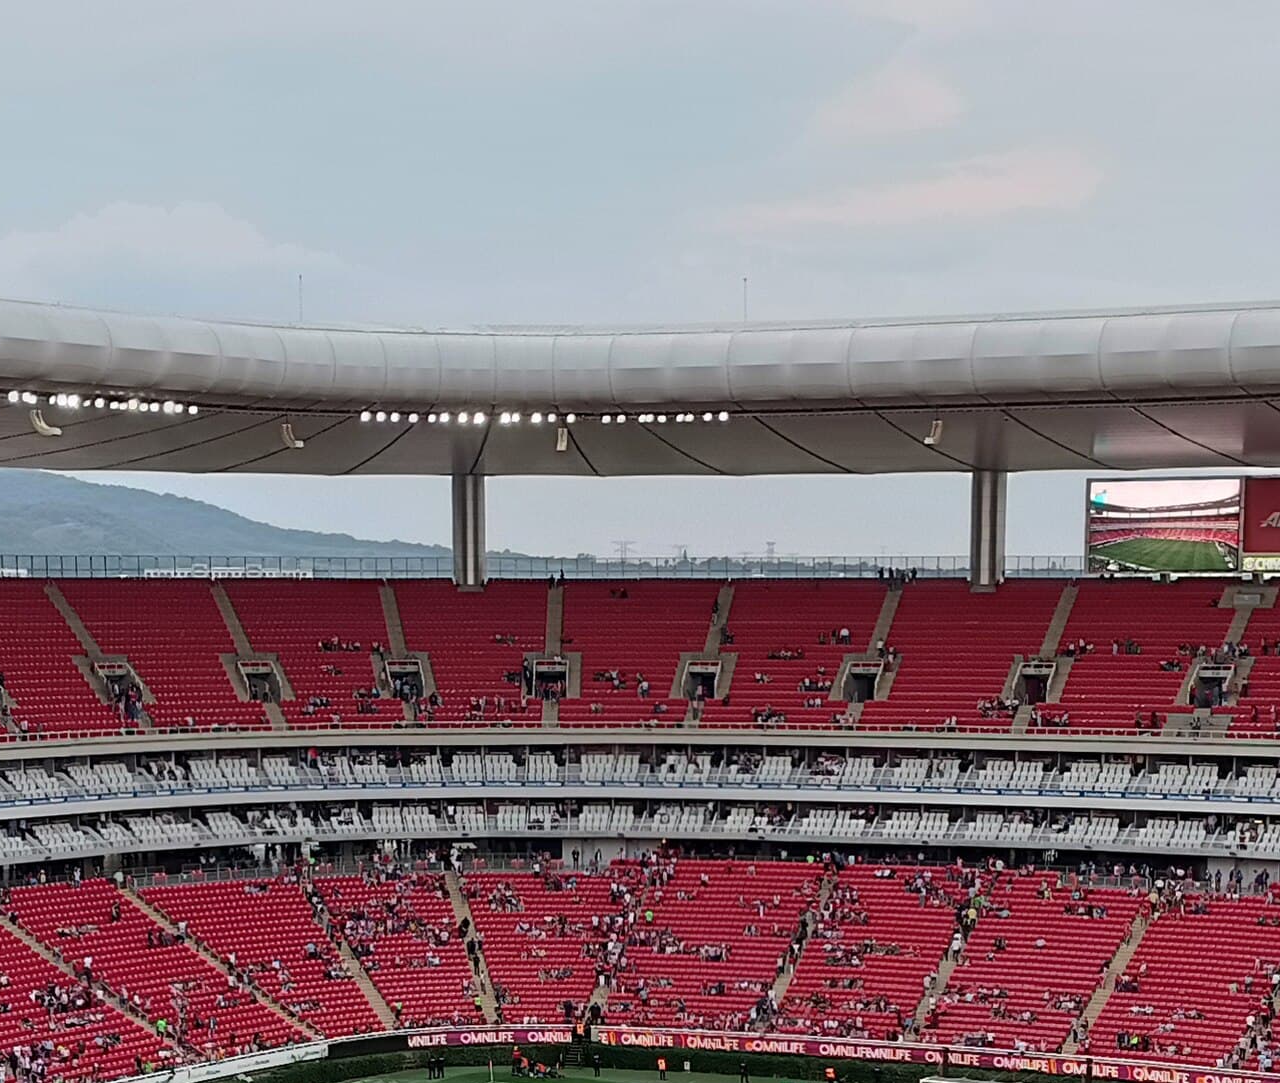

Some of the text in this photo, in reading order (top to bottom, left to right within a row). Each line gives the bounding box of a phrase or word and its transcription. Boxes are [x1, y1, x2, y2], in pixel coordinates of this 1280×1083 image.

[460, 1031, 515, 1045] OMNILIFE
[621, 1032, 673, 1048] OMNILIFE
[687, 1034, 739, 1050] OMNILIFE
[752, 1041, 806, 1054] OMNILIFE
[993, 1056, 1048, 1073] OMNILIFE
